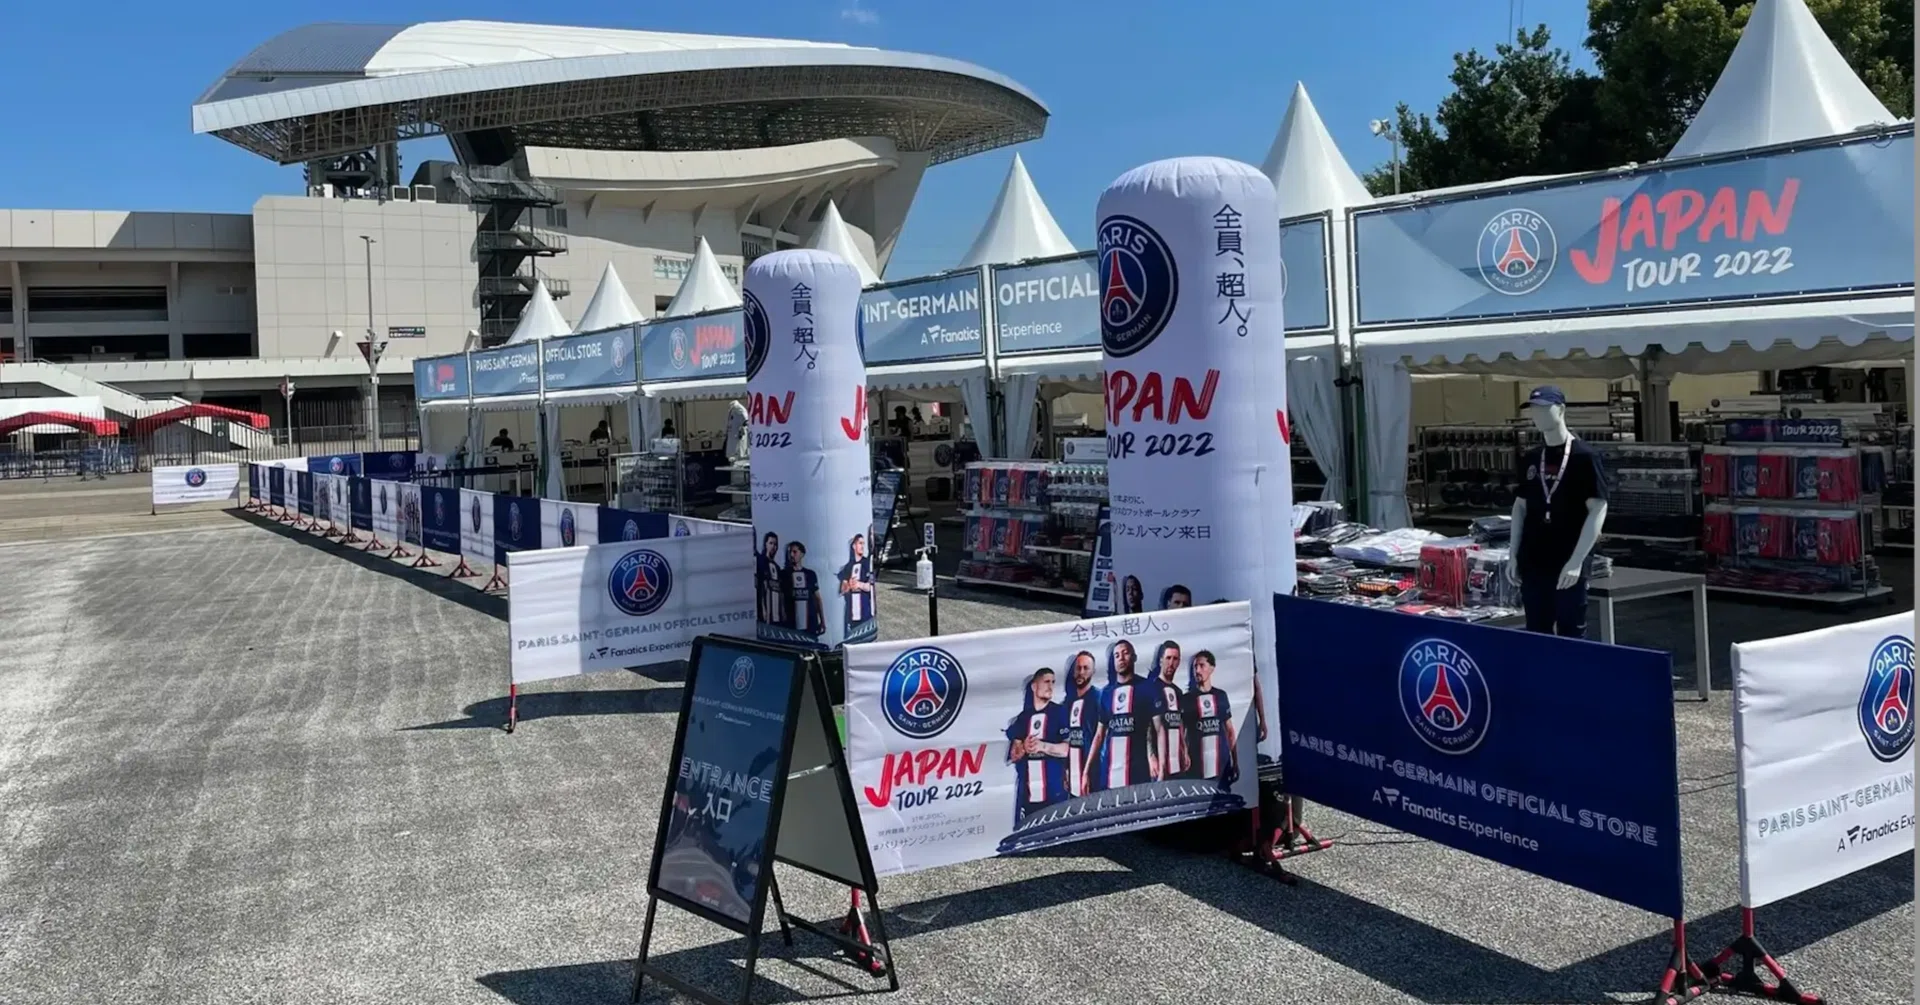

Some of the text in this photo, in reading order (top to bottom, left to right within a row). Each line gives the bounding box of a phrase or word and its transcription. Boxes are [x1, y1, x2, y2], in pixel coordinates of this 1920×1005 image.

[1099, 226, 1148, 254] ARIS
[1489, 213, 1541, 236] PARIS
[1569, 178, 1800, 284] JAPAN
[1213, 203, 1249, 337] 全員、超人。
[1622, 247, 1795, 292] TOUR 2022
[1000, 272, 1099, 307] OFFICIAL
[791, 282, 816, 370] 全員、超人。
[920, 322, 1063, 346] A Fanatics Experience
[545, 346, 577, 362] OFFICIAL
[577, 341, 602, 360] STORE
[1104, 368, 1220, 427] PAN
[755, 432, 793, 449] 2022
[1145, 431, 1216, 457] 2022
[1807, 425, 1839, 436] 2022
[621, 554, 661, 572] PARIS
[518, 609, 756, 650] PARIS SAINT-GERMAIN OFFICIAL STORE
[1069, 615, 1170, 643] 全員、超人。
[588, 638, 692, 660] A Fanatics Experienc
[897, 653, 950, 676] PARIS
[1412, 645, 1471, 676] PARIS
[1876, 645, 1915, 678] PARIS
[898, 707, 950, 729] SAINT GERMAIN
[1109, 717, 1135, 729] QATAR
[1197, 719, 1221, 731] QATAR
[1415, 715, 1475, 745] SAINT GERMAIN
[679, 756, 774, 803] ENTRANCE
[864, 743, 987, 808] JAPAN
[1288, 730, 1658, 847] PARIS SAINT-GERMAIN OFFICIAL STORE
[702, 792, 733, 823] 入口
[896, 780, 984, 811] TOUR 2022
[1758, 772, 1914, 838] PARIS SAINT-GERMAIN
[1372, 789, 1539, 851] A Fanatics Experience
[1837, 837, 1846, 853] A
[1861, 820, 1899, 844] Fanatics
